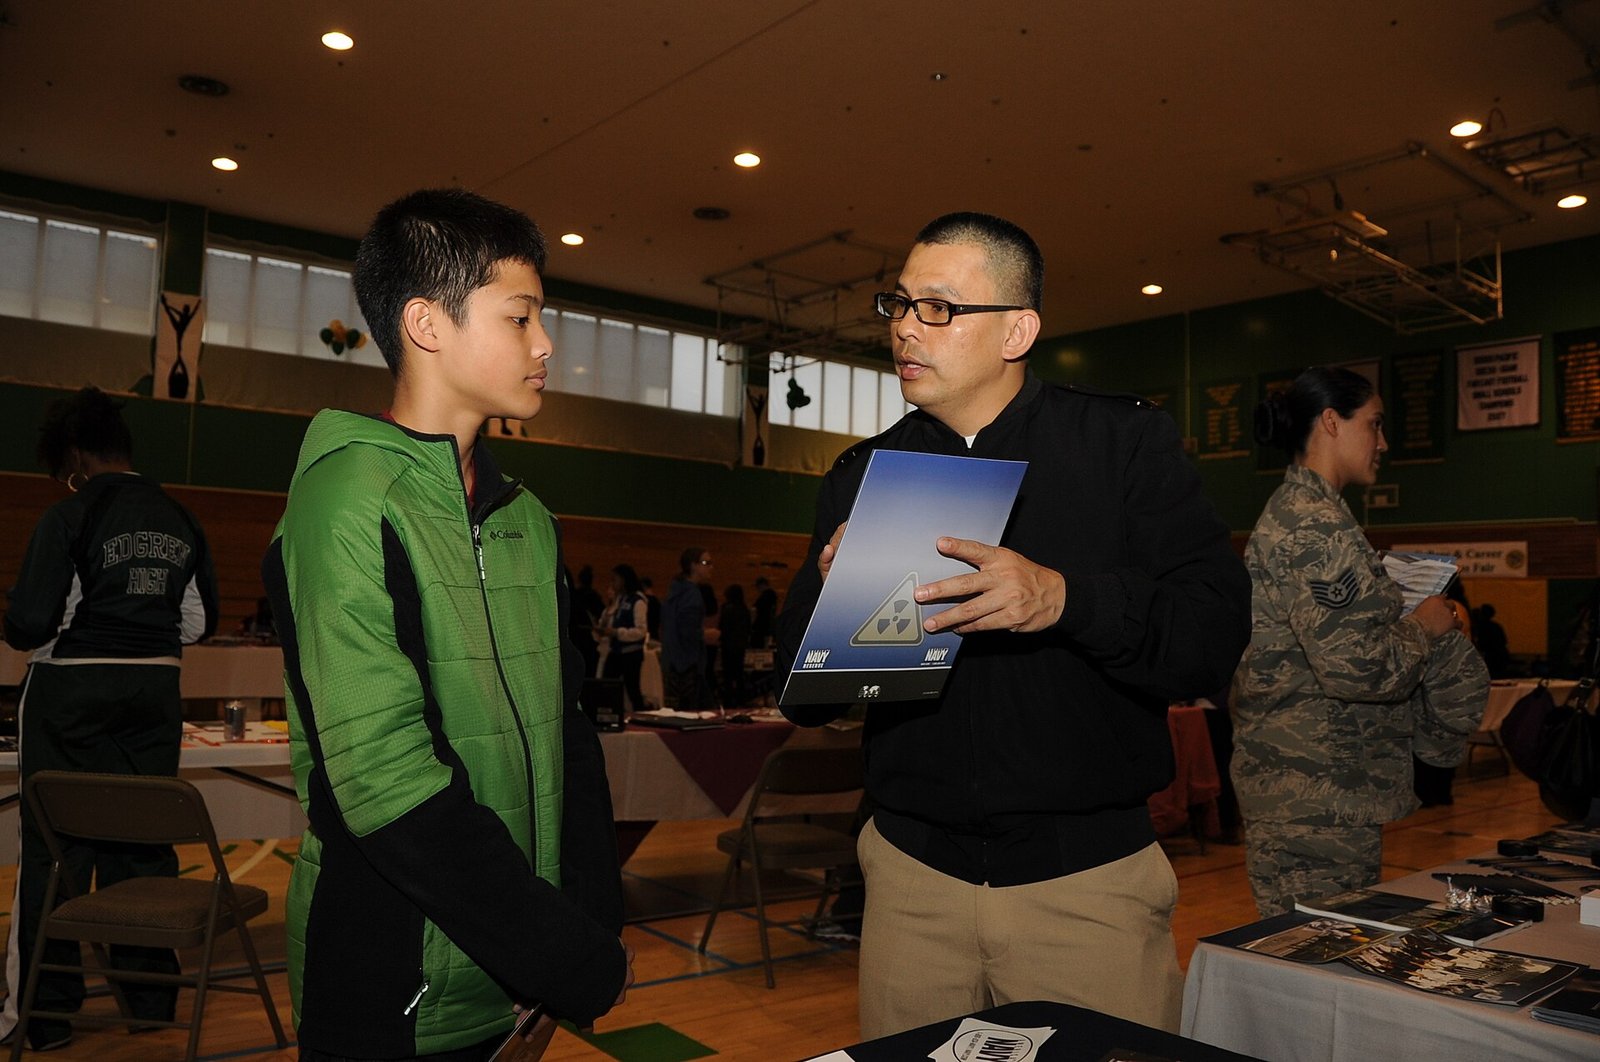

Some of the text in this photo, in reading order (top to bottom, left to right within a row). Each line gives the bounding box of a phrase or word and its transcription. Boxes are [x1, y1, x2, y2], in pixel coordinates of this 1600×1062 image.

[103, 531, 191, 568] EDGREN
[1466, 549, 1503, 559] Career
[126, 567, 169, 596] HIGH
[805, 649, 831, 664] NAVY
[925, 648, 949, 662] NAVY
